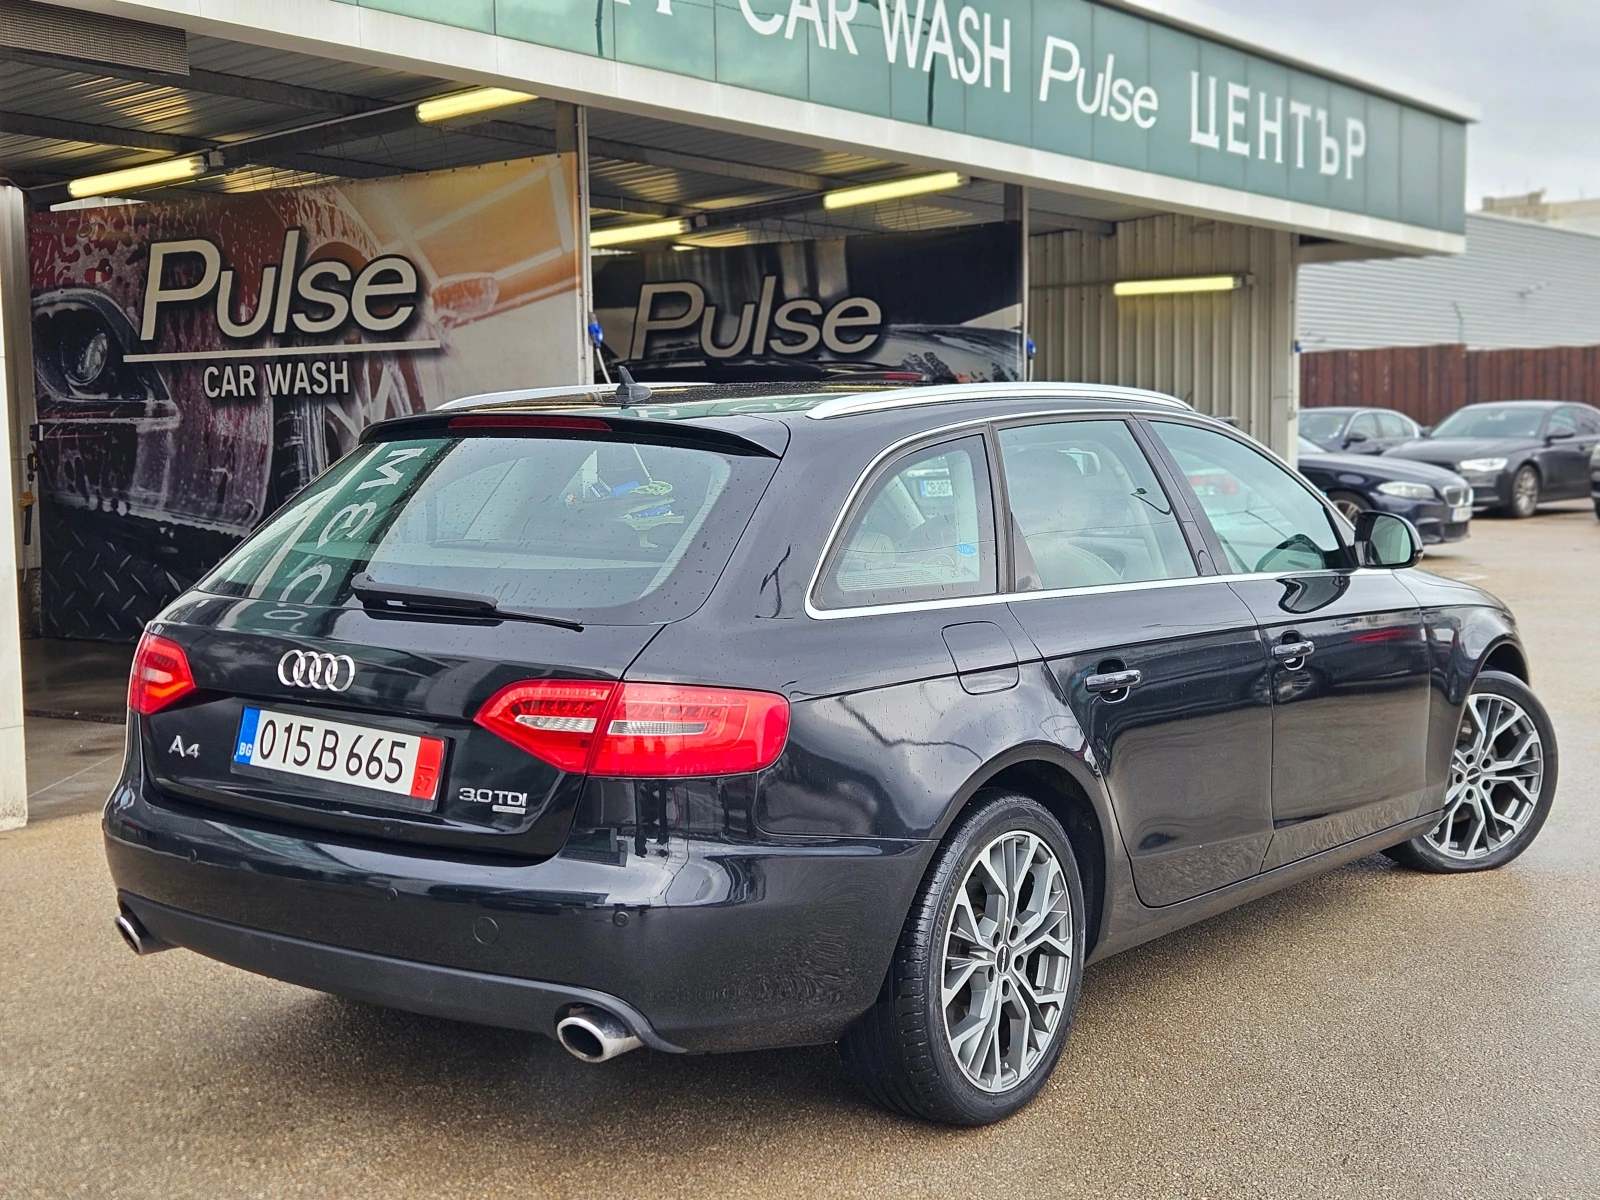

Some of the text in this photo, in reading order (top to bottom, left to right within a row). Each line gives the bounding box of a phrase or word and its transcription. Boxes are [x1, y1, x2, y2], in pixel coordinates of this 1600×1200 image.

[878, 0, 1011, 93] WASH
[1039, 36, 1159, 129] Pulse
[1189, 71, 1366, 180] ЦЕНТЪР
[140, 229, 418, 341] Pulse
[629, 275, 882, 361] Pulse
[203, 360, 350, 398] CAR WASH
[167, 734, 200, 759] A4
[238, 741, 253, 757] BG
